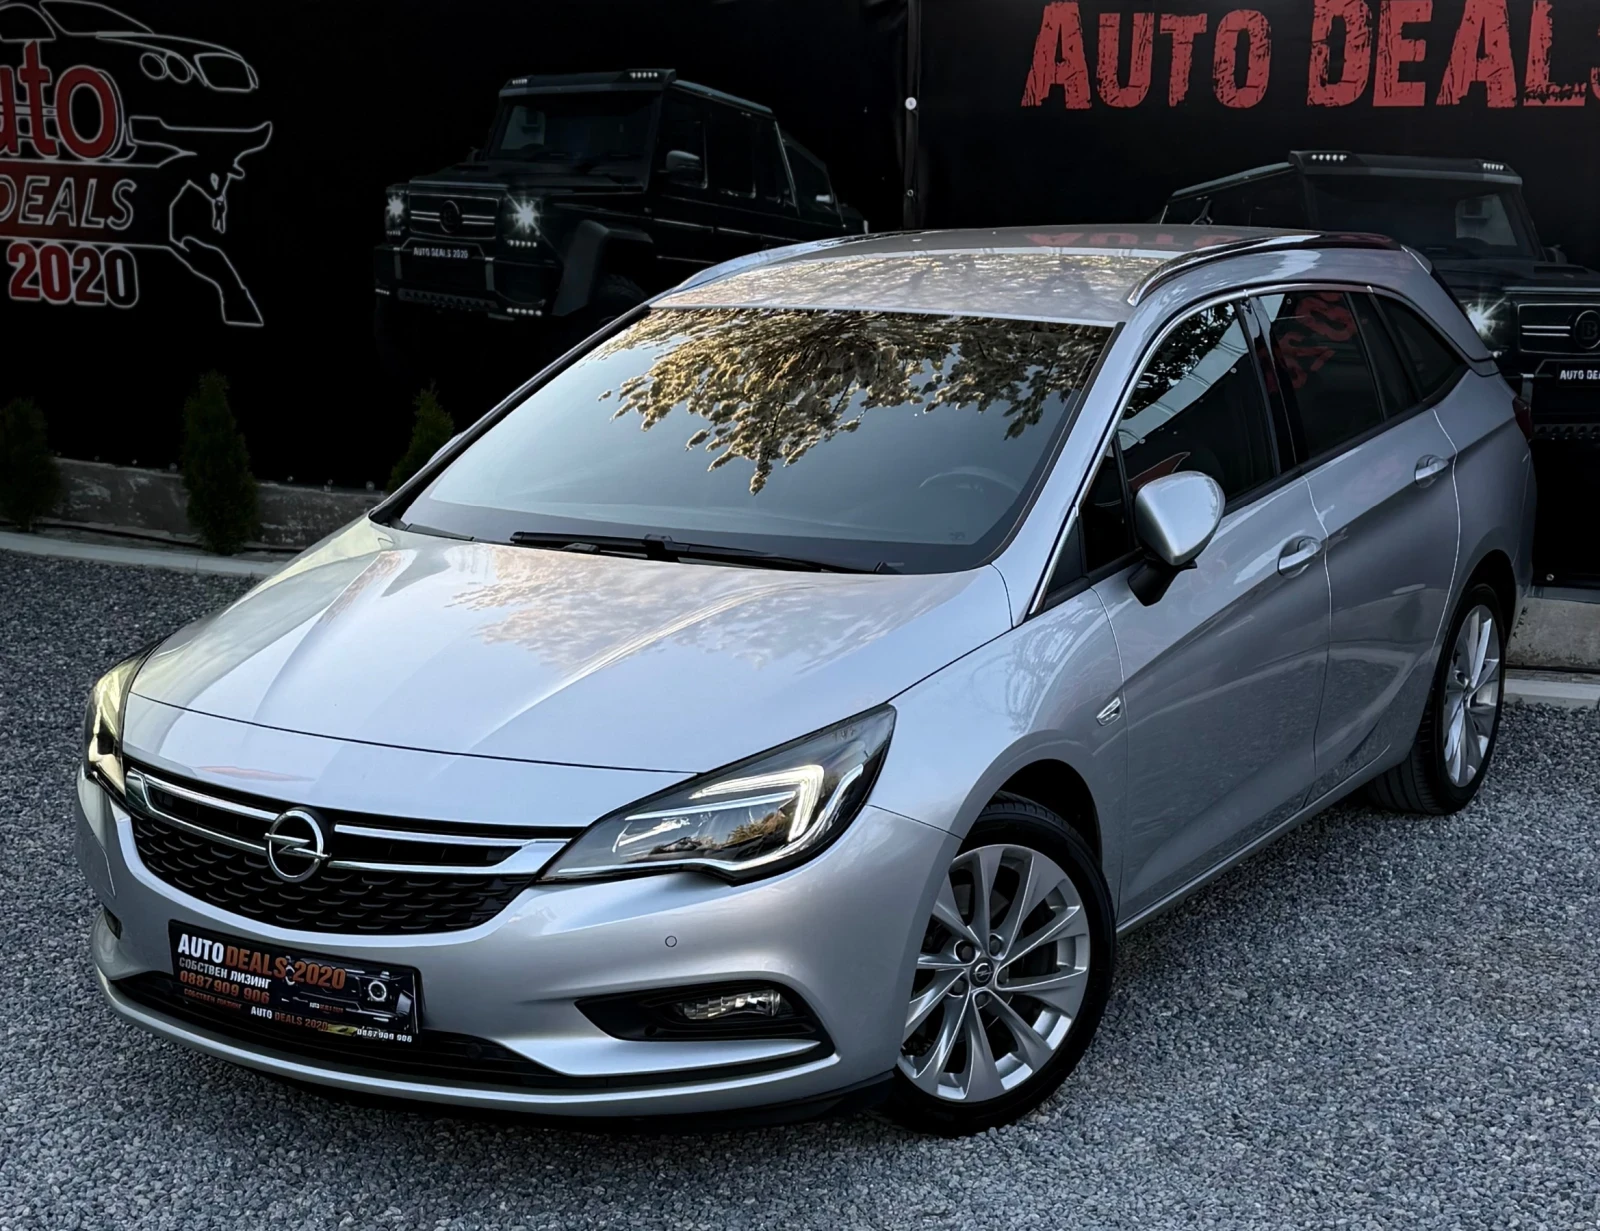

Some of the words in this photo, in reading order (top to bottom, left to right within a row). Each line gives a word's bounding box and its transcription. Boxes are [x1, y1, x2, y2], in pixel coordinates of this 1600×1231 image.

[1021, 1, 1271, 109] AUTO
[1306, 0, 1600, 108] DEAL
[6, 239, 139, 309] 2020
[1560, 369, 1584, 380] AUTO
[177, 933, 225, 964] AUTO
[225, 945, 288, 979] DEALS
[293, 961, 347, 990] 2020
[179, 957, 228, 979] СОБСТВЕН
[230, 970, 272, 989] ЛИЗИНГ
[180, 970, 213, 989] 0887
[213, 979, 239, 997] 909
[243, 987, 270, 1004] 906
[250, 1006, 273, 1020] AUTO
[274, 1011, 303, 1026] DEALS
[304, 1018, 328, 1031] 2020
